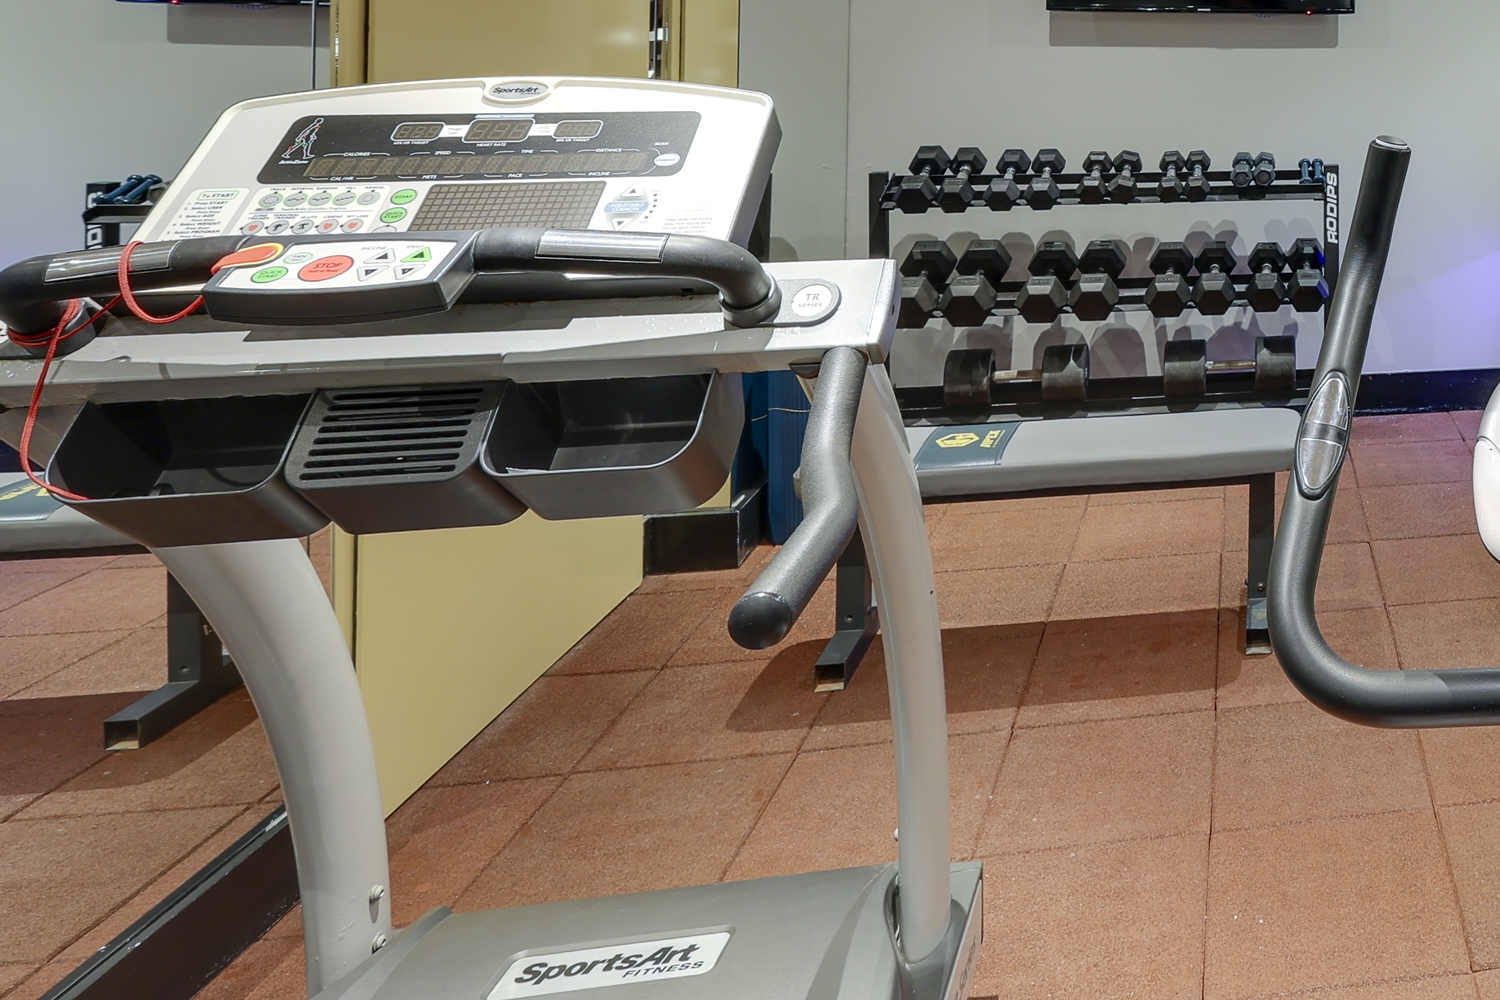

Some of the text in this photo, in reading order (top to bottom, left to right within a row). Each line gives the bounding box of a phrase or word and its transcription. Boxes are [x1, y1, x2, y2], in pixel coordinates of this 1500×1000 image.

[1326, 172, 1338, 244] RODIPS
[514, 944, 701, 986] SportsArt
[622, 960, 704, 978] FITNESS
